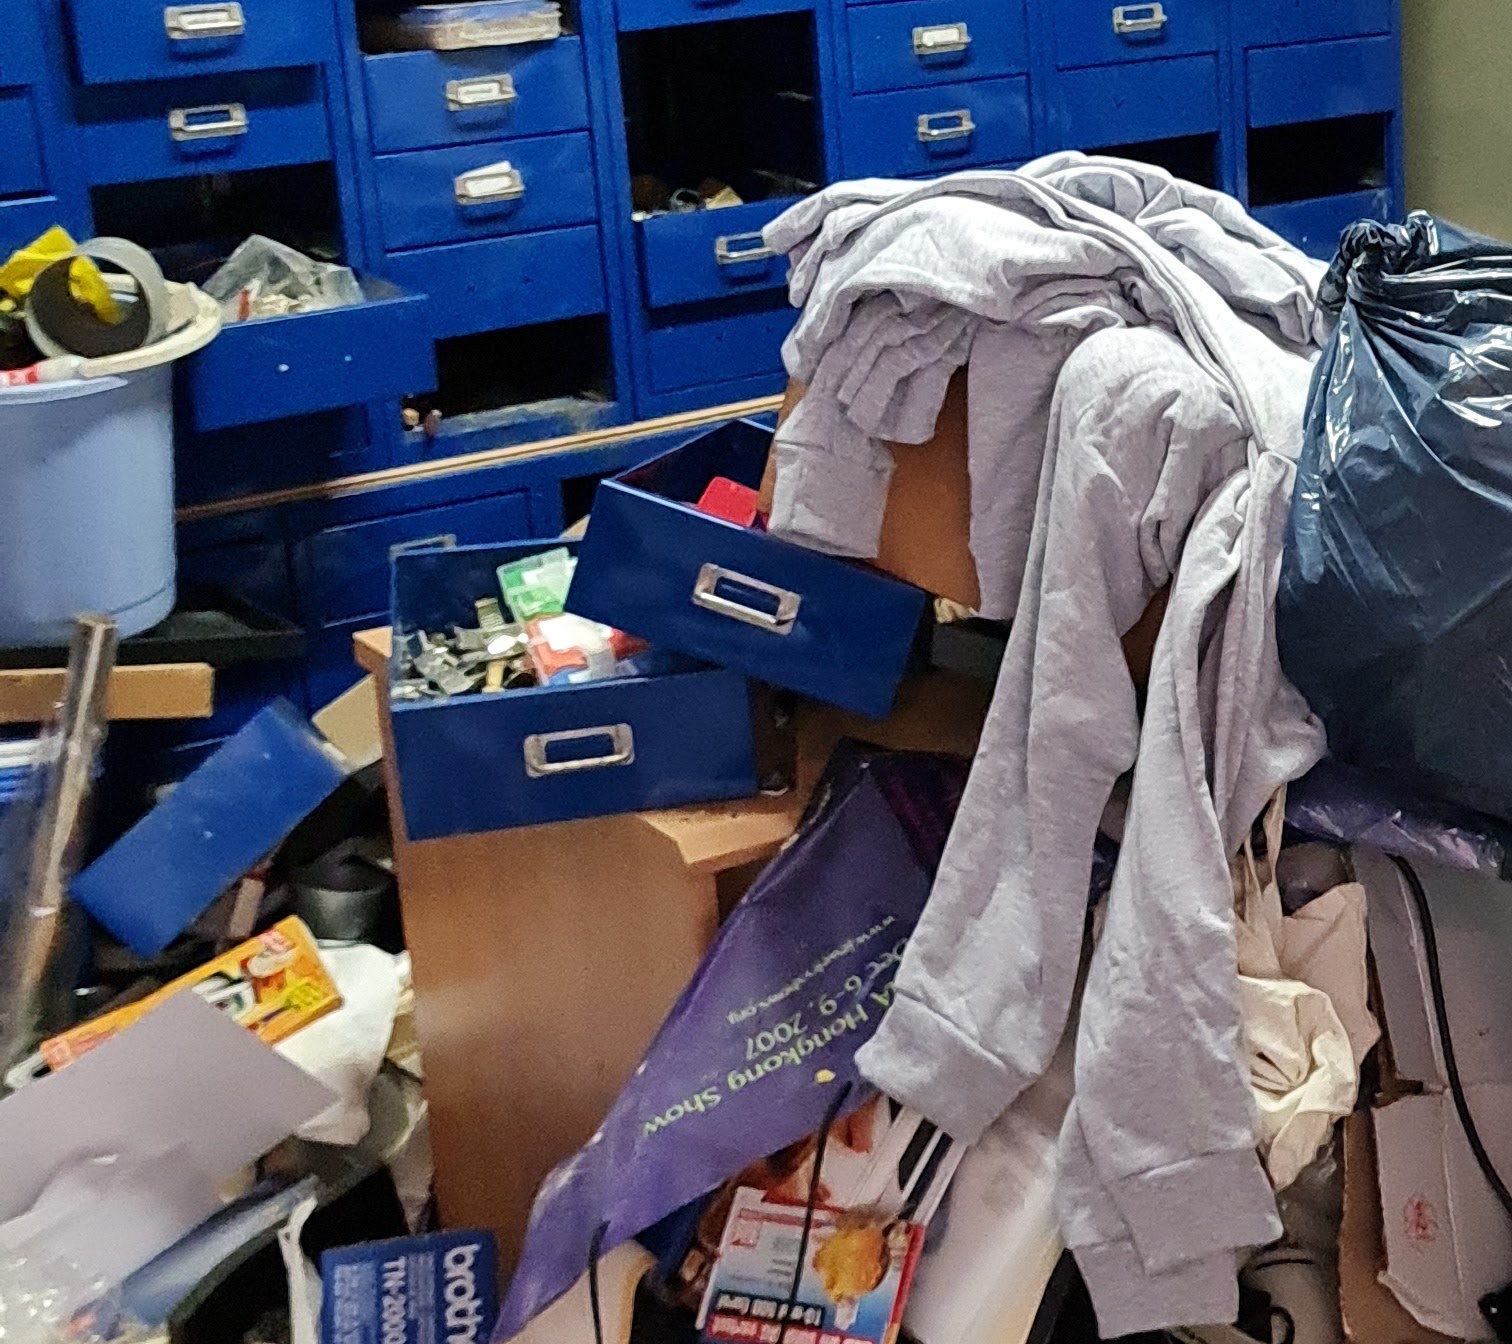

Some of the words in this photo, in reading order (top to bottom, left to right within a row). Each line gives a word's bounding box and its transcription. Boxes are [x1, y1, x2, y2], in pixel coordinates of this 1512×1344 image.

[722, 1003, 870, 1093] Hongkong
[737, 1008, 809, 1065] 2007
[638, 1085, 723, 1138] Show
